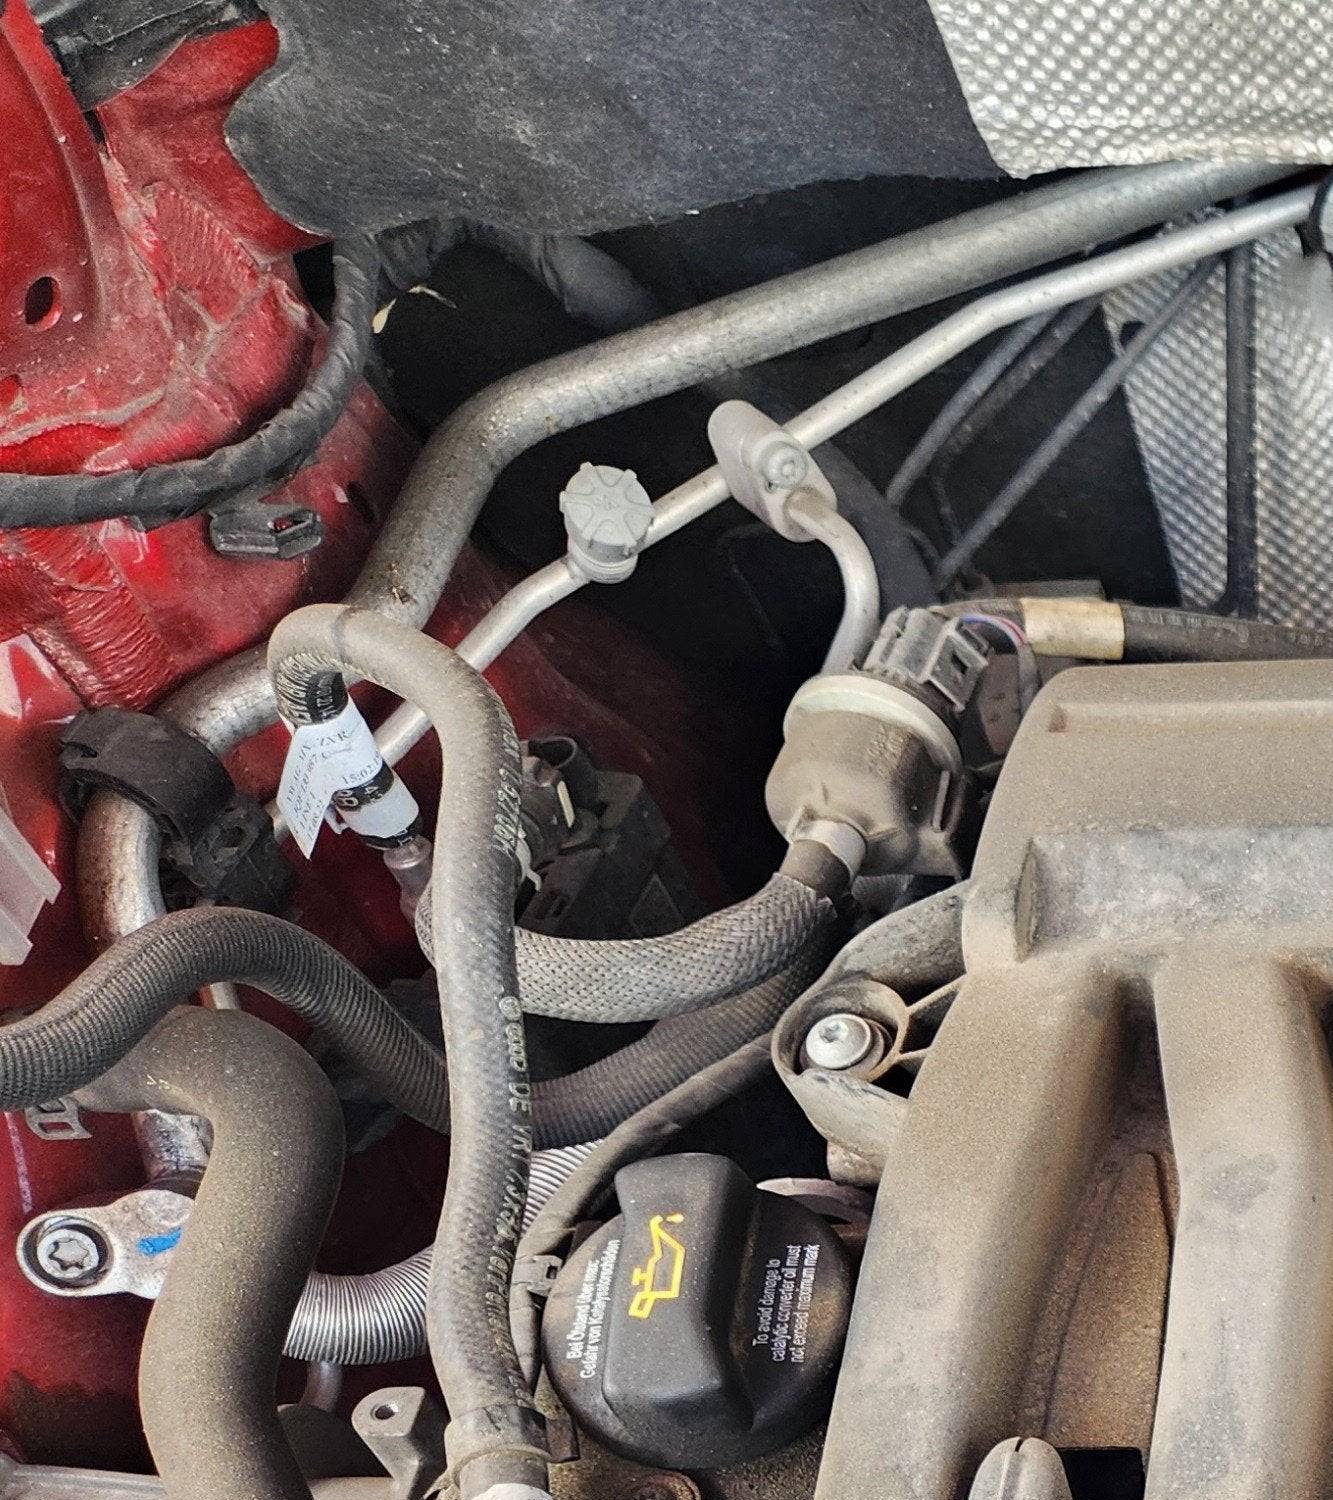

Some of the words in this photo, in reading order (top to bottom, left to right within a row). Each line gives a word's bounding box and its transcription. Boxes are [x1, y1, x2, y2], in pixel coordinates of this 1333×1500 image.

[766, 1259, 781, 1269] to
[786, 1245, 802, 1267] must
[803, 1244, 820, 1267] mark
[781, 1267, 797, 1279] oil
[760, 1270, 782, 1306] damage
[795, 1267, 816, 1311] maximum
[777, 1279, 796, 1322] converter
[757, 1307, 774, 1332] avoid
[792, 1312, 809, 1346] exceed
[752, 1334, 769, 1347] To
[771, 1323, 792, 1362] catalytic
[789, 1347, 805, 1363] not
